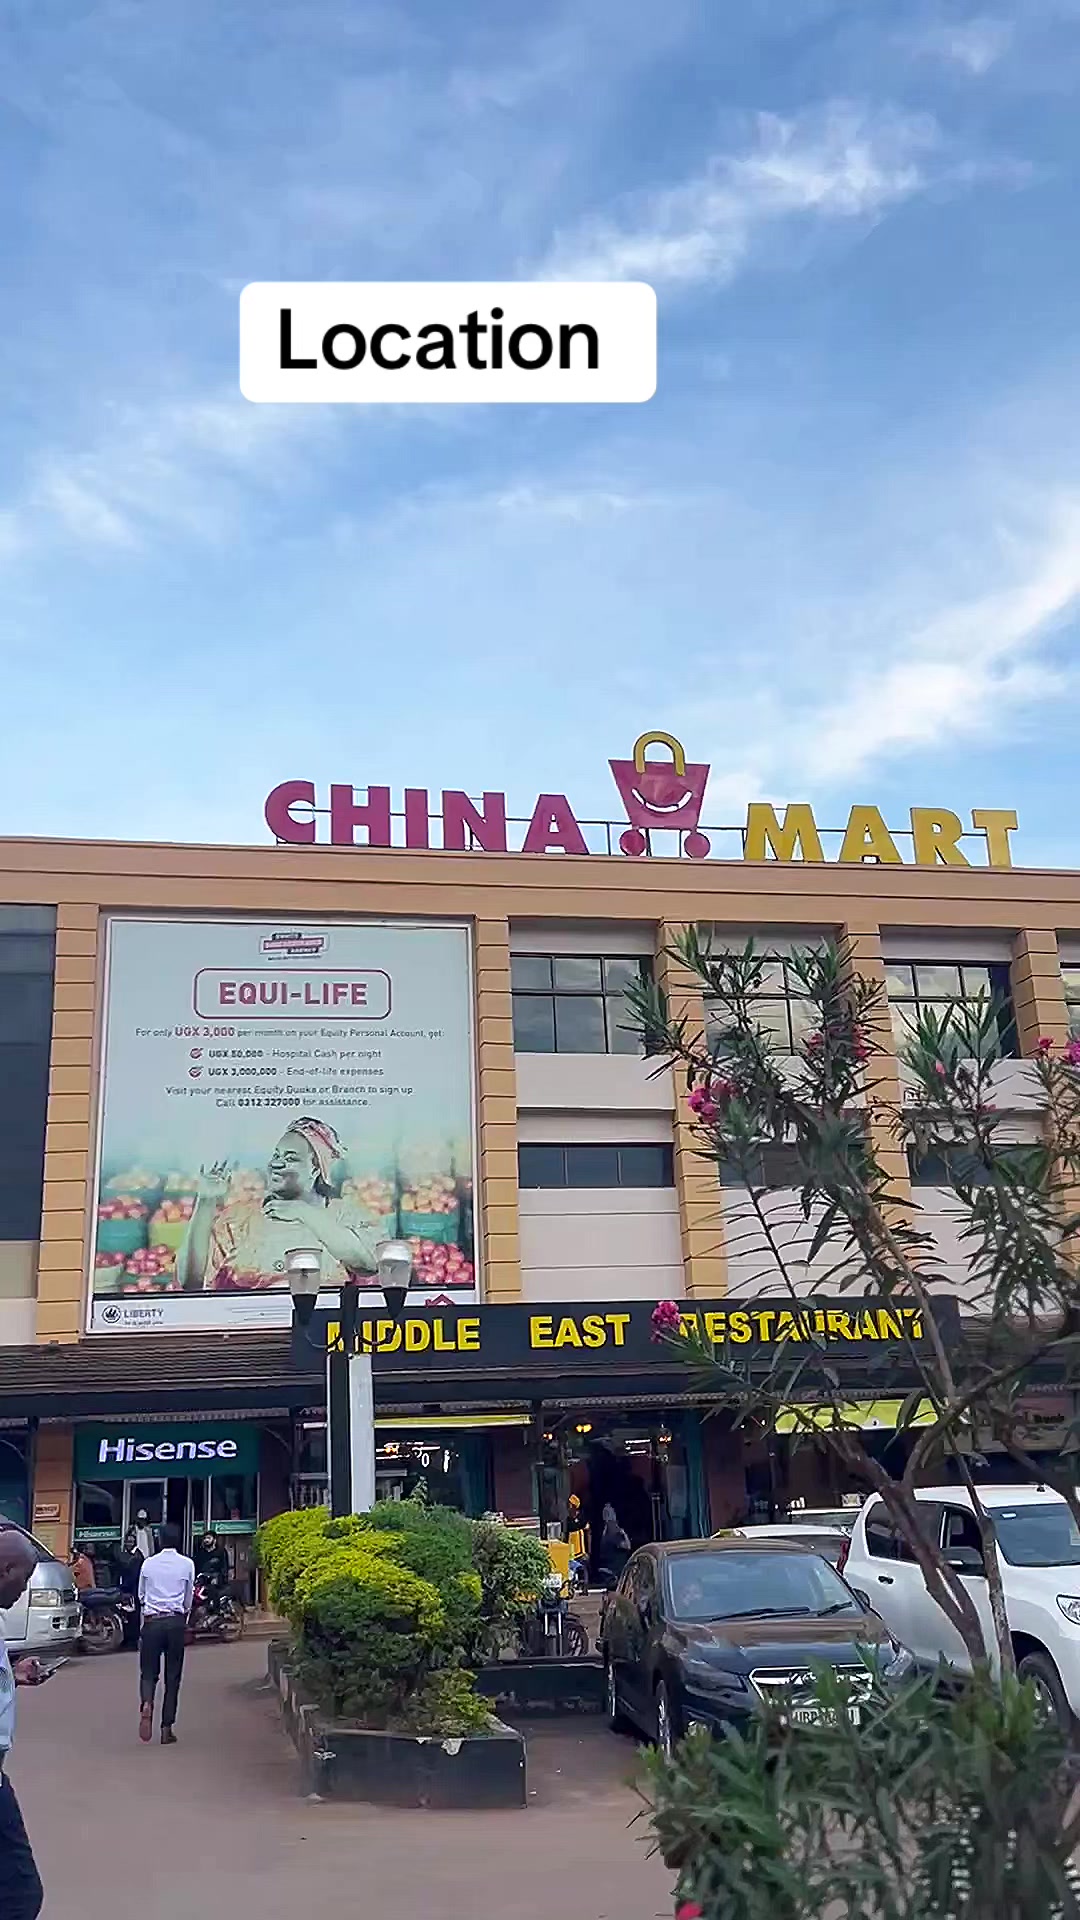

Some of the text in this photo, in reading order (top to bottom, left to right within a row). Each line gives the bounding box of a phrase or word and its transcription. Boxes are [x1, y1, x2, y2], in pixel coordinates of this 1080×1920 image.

[264, 779, 1019, 868] CHINA MART
[218, 981, 369, 1006] EQUI-LIFE
[135, 1027, 151, 1037] For
[152, 1027, 173, 1039] only
[174, 1026, 200, 1037] UGX
[202, 1026, 235, 1038] 3,000
[237, 1029, 252, 1039] per
[320, 1028, 348, 1040] Equity
[349, 1028, 388, 1038] Personal
[208, 1049, 229, 1058] UGX
[272, 1049, 312, 1059] Hospital
[313, 1049, 337, 1058] Cash
[339, 1051, 355, 1060] per
[357, 1050, 382, 1060] night
[208, 1067, 229, 1076] UGX
[339, 1068, 385, 1077] expenses
[165, 1086, 187, 1095] Visit
[189, 1088, 211, 1097] your
[213, 1087, 252, 1095] nearest
[254, 1085, 285, 1096] Equity
[331, 1085, 366, 1094] Branch
[367, 1086, 378, 1094] to
[379, 1087, 400, 1096] sign
[215, 1098, 236, 1107] Call
[123, 1308, 164, 1318] LIBERTY
[529, 1313, 631, 1349] EAST
[98, 1438, 238, 1464] Hisense
